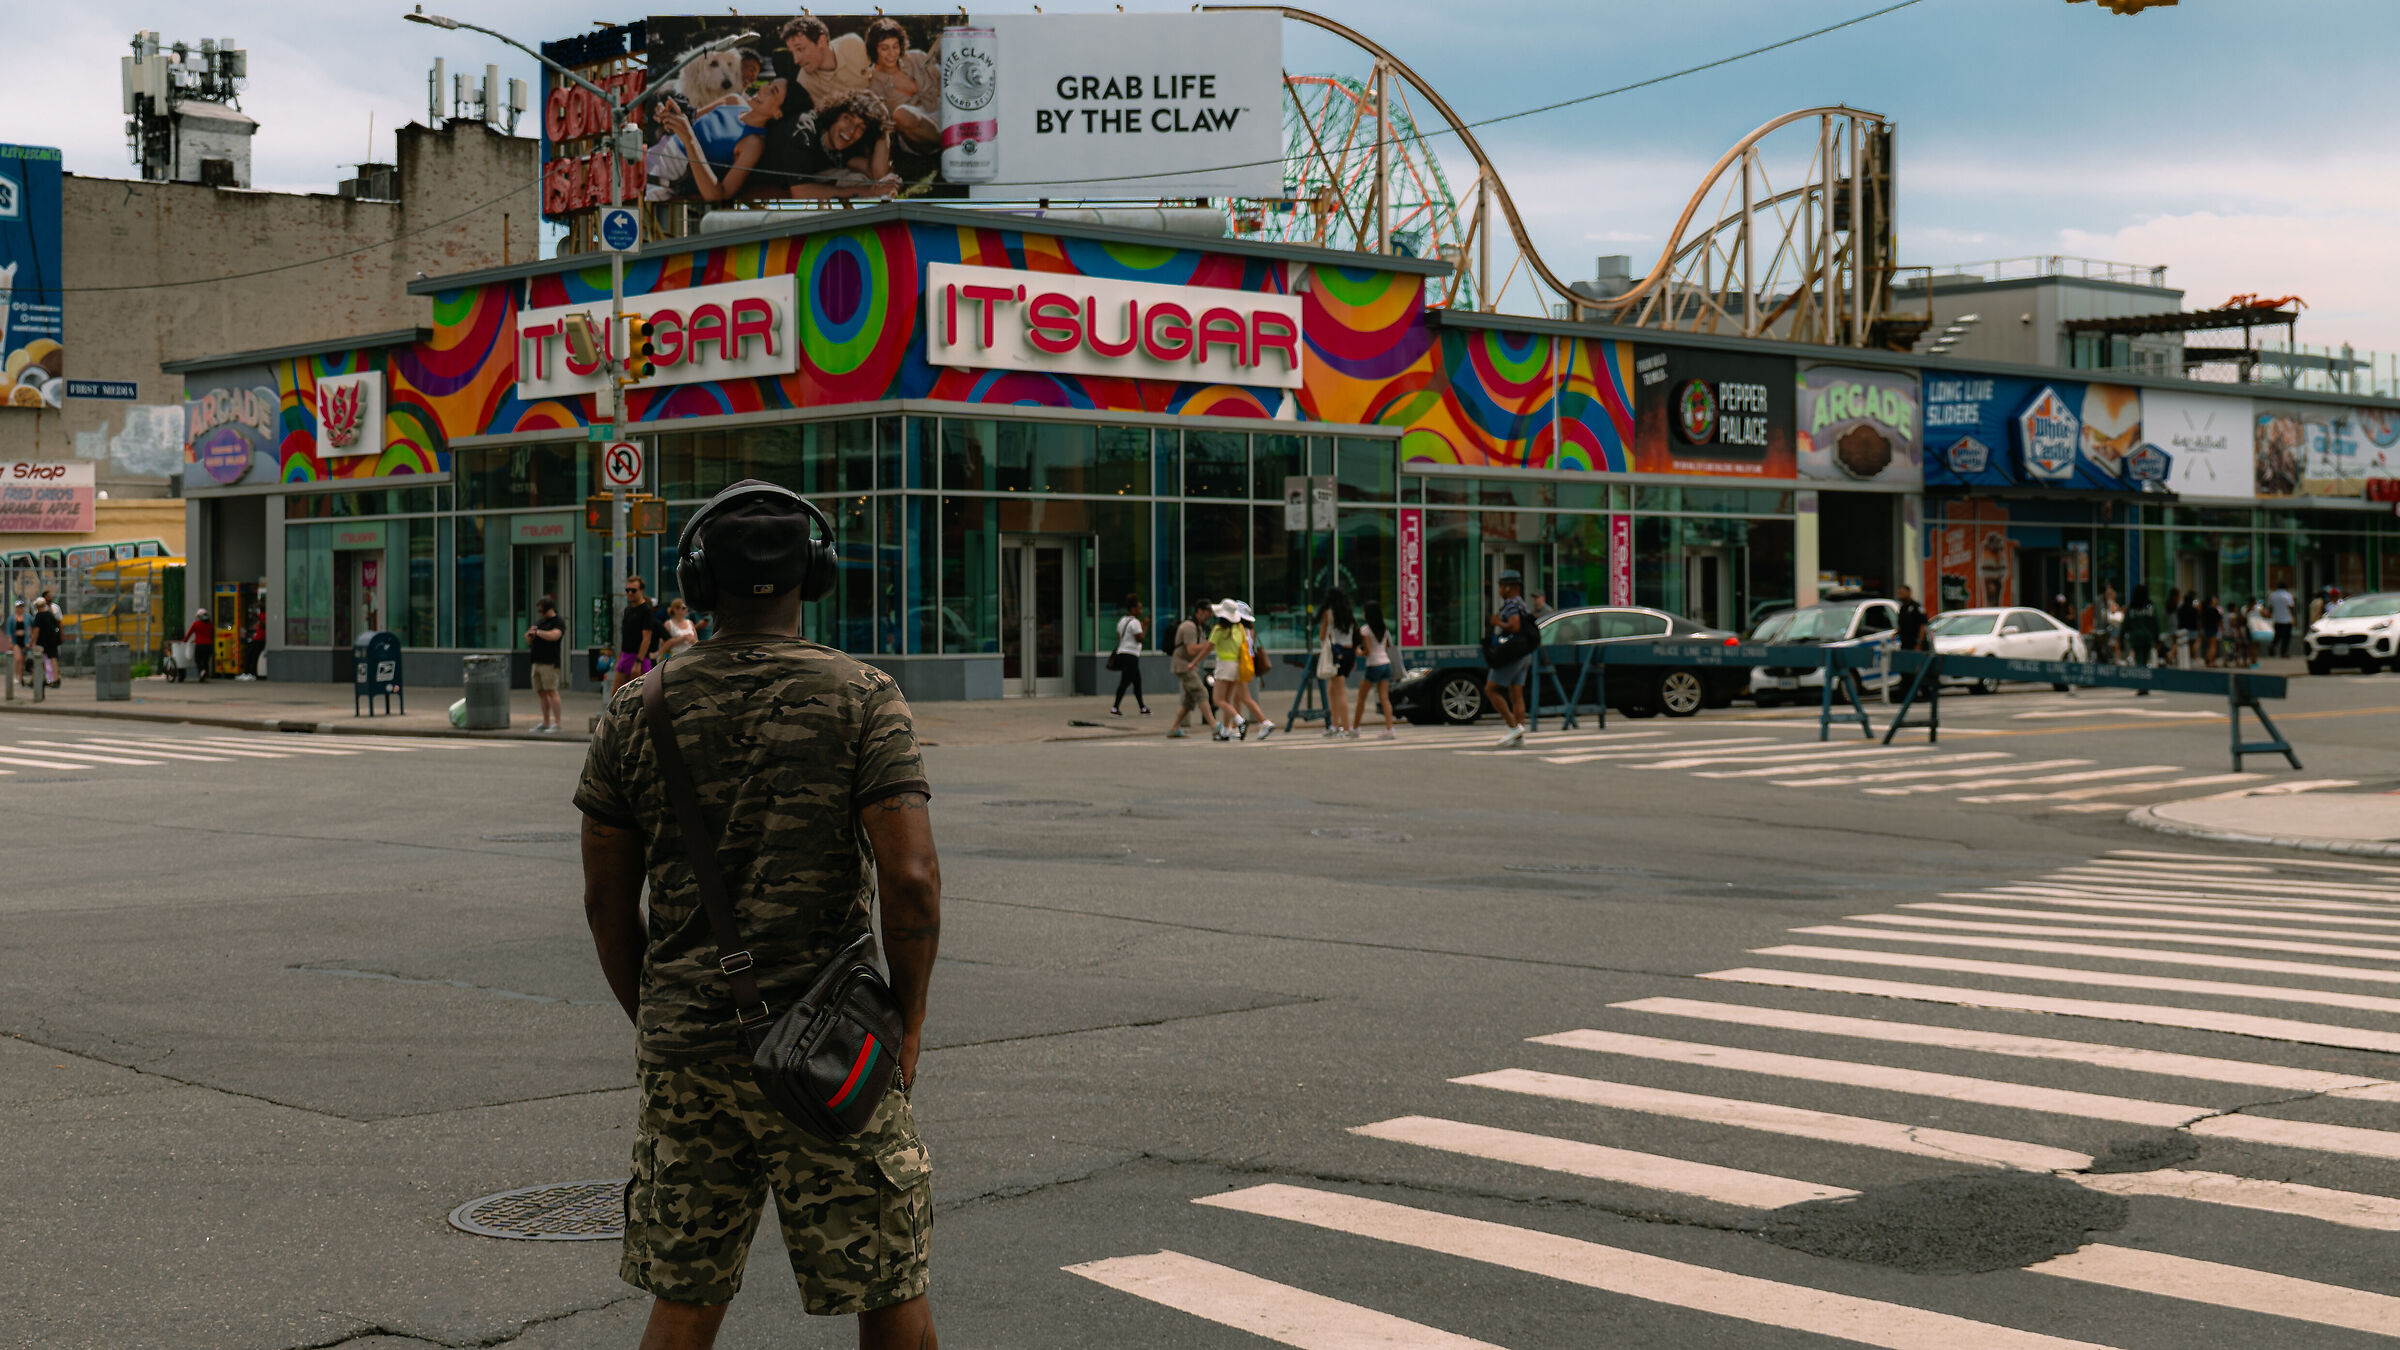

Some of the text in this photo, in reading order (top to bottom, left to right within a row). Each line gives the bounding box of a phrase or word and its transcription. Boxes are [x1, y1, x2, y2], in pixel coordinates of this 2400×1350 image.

[943, 47, 993, 89] WHITE CLAW
[1056, 74, 1216, 100] GRAB LIFE
[1036, 109, 1074, 133] BY
[1081, 109, 1142, 133] THE
[946, 283, 1298, 370] IT'SUGAR
[70, 384, 99, 395] FIRST
[1719, 382, 1767, 412] PEPPER
[1928, 380, 1994, 402] LONG LIVE
[188, 387, 273, 444] ARCADE
[1811, 383, 1913, 440] ARCADE
[1719, 416, 1768, 446] PALACE
[2035, 417, 2071, 440] White
[13, 463, 66, 480] Shop
[0, 502, 81, 515] ARAMEL APPLE
[1617, 520, 1629, 607] IT'SUG
